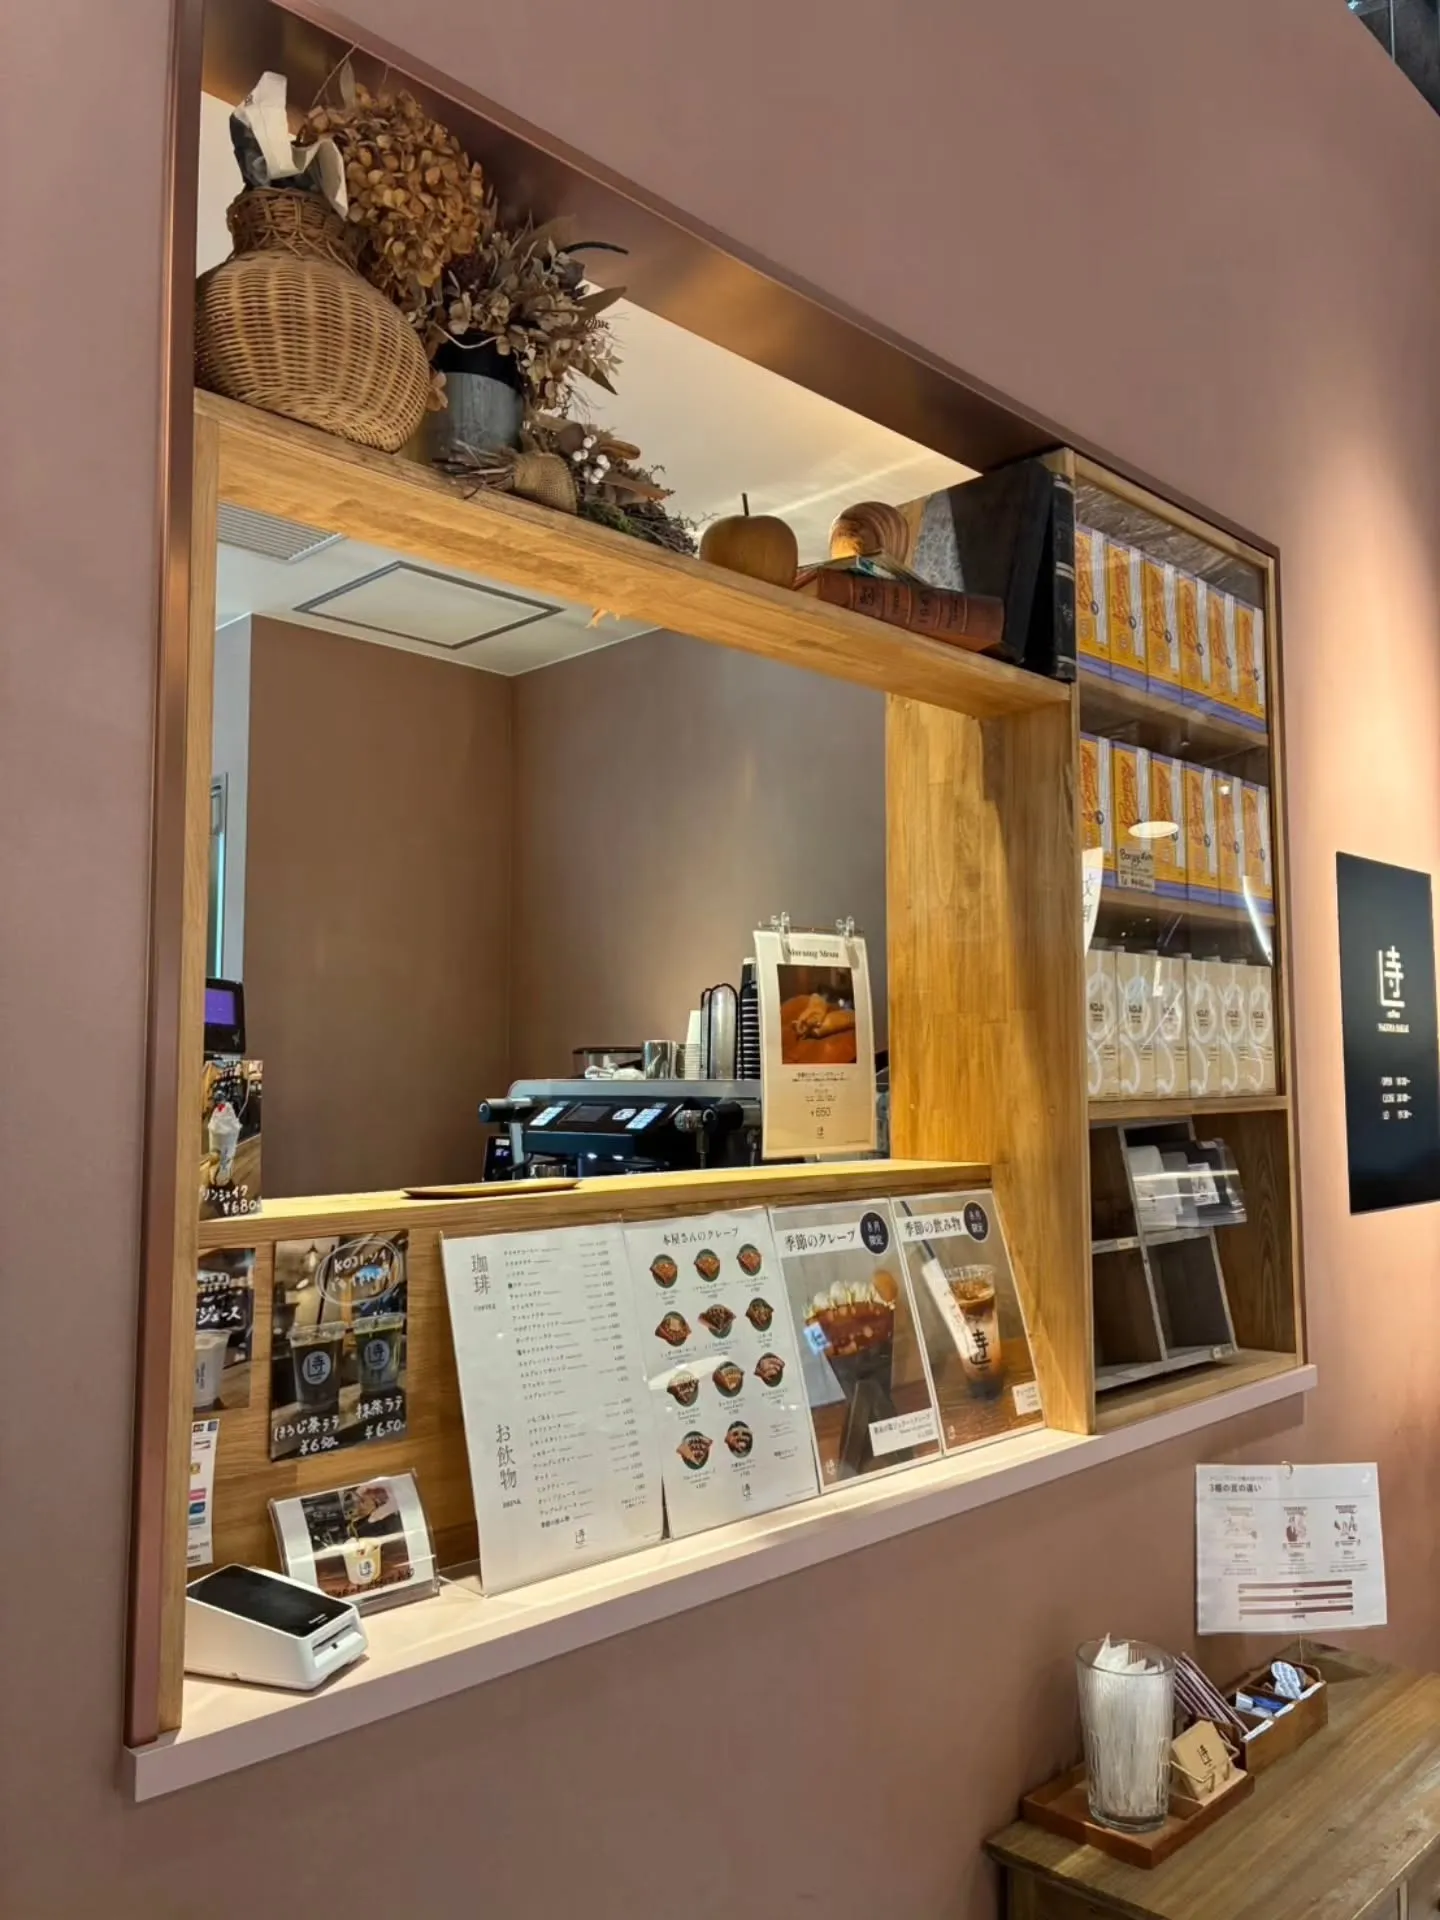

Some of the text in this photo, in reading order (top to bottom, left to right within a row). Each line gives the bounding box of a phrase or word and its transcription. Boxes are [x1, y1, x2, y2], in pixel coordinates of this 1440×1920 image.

[784, 1227, 856, 1253] 季節のクレープ
[904, 1215, 961, 1239] 季節の飲み物
[470, 1252, 492, 1297] 珈琲
[196, 1305, 242, 1326] ジュース
[355, 1394, 404, 1420] 抹茶ラテ
[273, 1413, 341, 1442] ほうじ茶ラテ
[495, 1423, 517, 1492] お飲物
